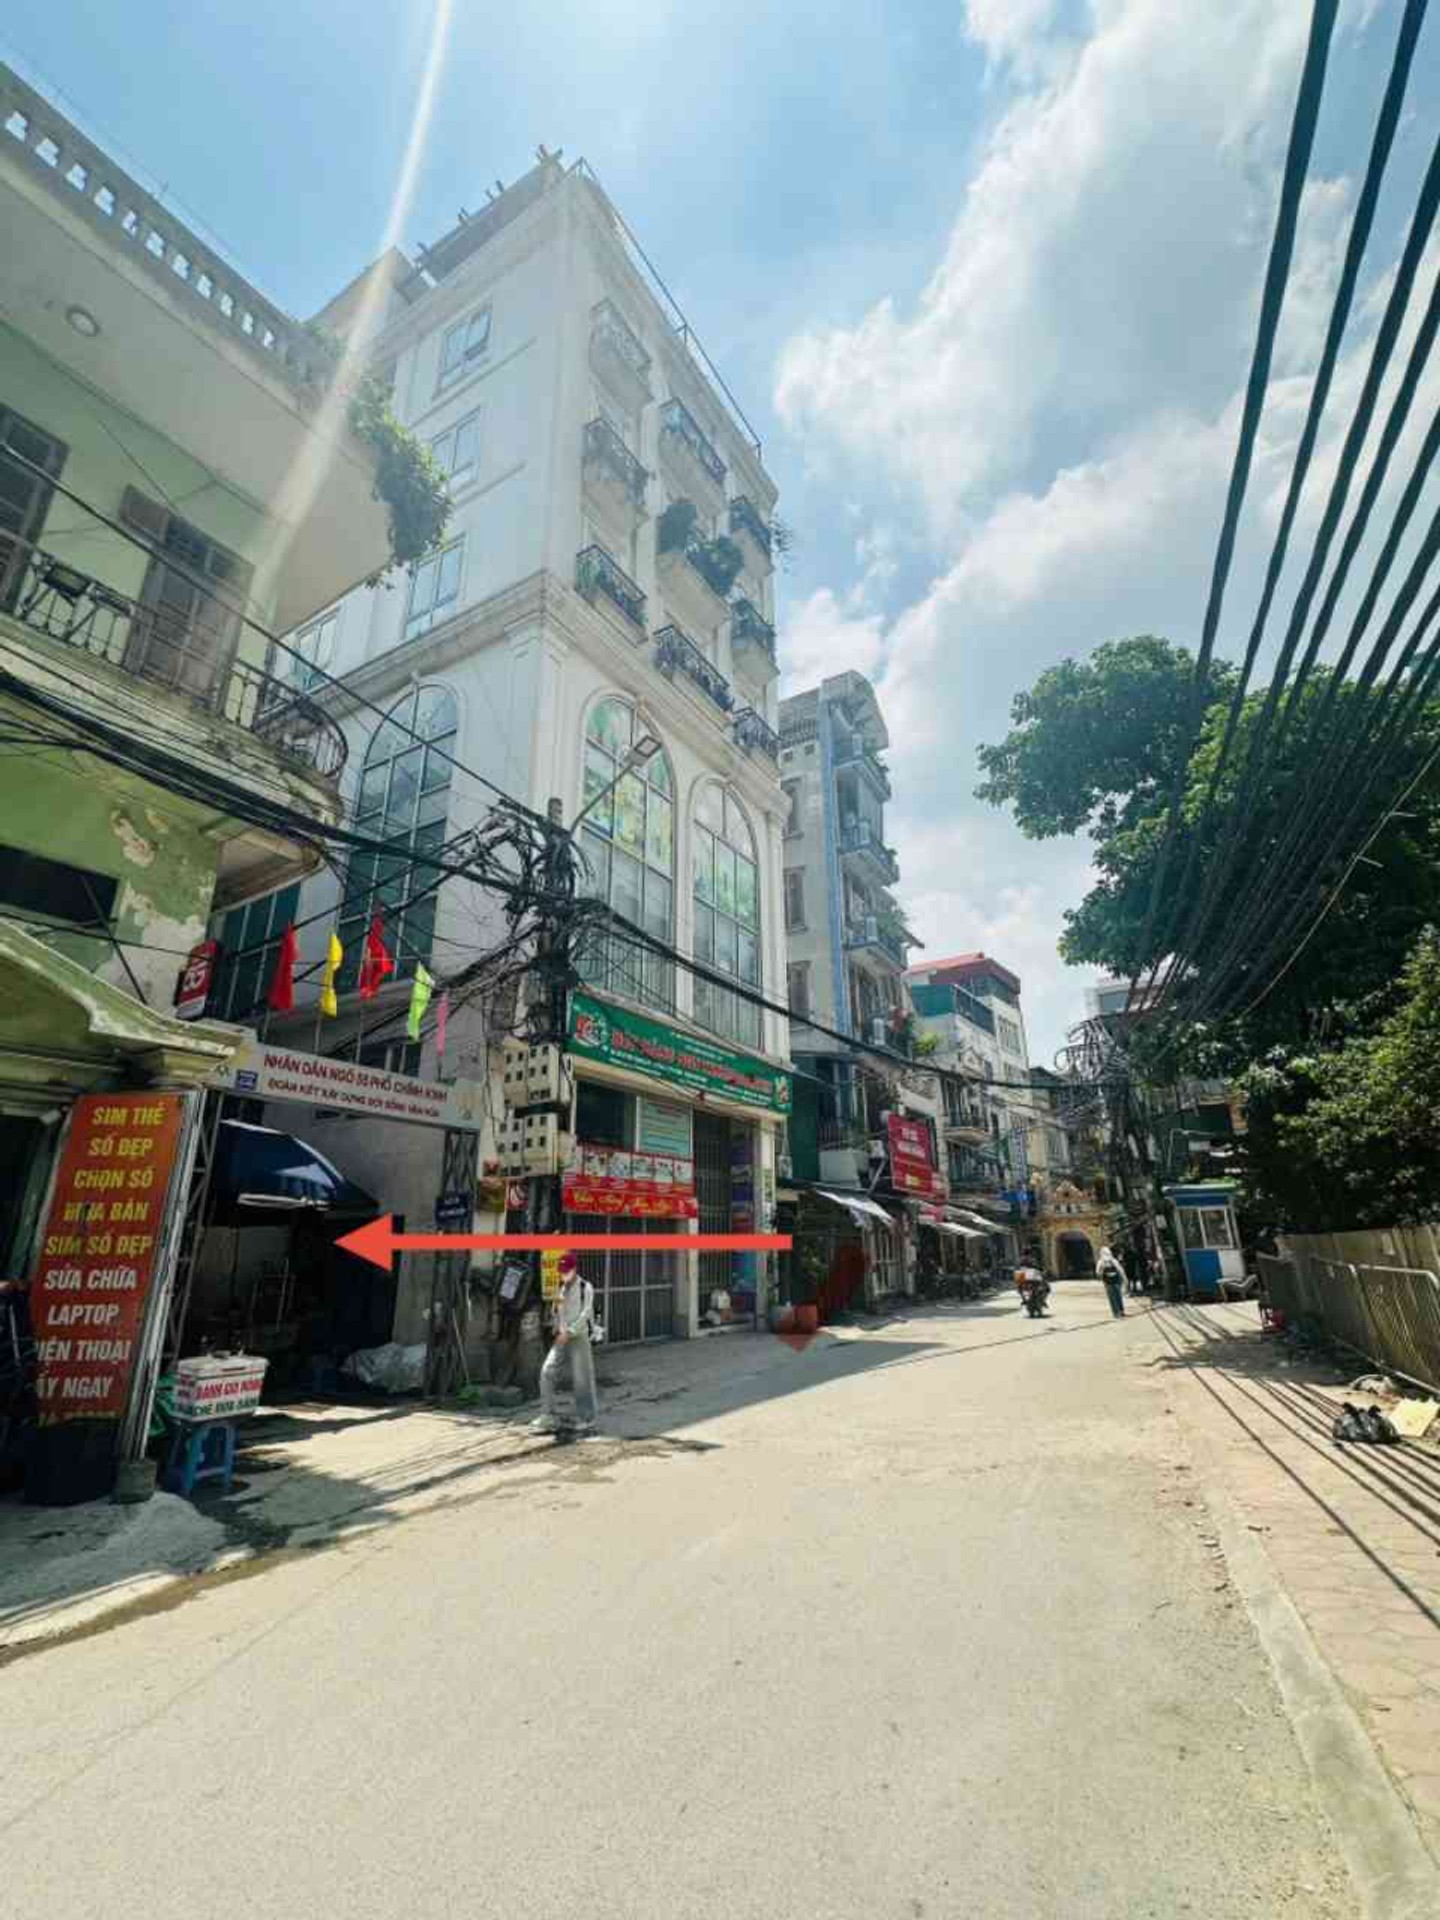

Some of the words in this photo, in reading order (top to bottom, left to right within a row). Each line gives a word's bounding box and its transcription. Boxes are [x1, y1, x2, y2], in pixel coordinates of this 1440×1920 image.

[92, 1107, 127, 1126] SIM
[132, 1101, 166, 1127] THẺ
[88, 1131, 118, 1156] SỐ
[74, 1168, 123, 1193] CHỌN
[127, 1165, 156, 1188] SỐ
[46, 1236, 82, 1256] SIM
[86, 1228, 115, 1256] SỐ
[116, 1235, 153, 1259] ĐẸP
[44, 1262, 82, 1291] SỬA
[87, 1263, 138, 1290] CHỮA
[48, 1302, 120, 1327] LAPTOP
[34, 1336, 71, 1367] IỆN
[77, 1339, 132, 1364] THOẠI
[62, 1375, 114, 1399] NGAY
